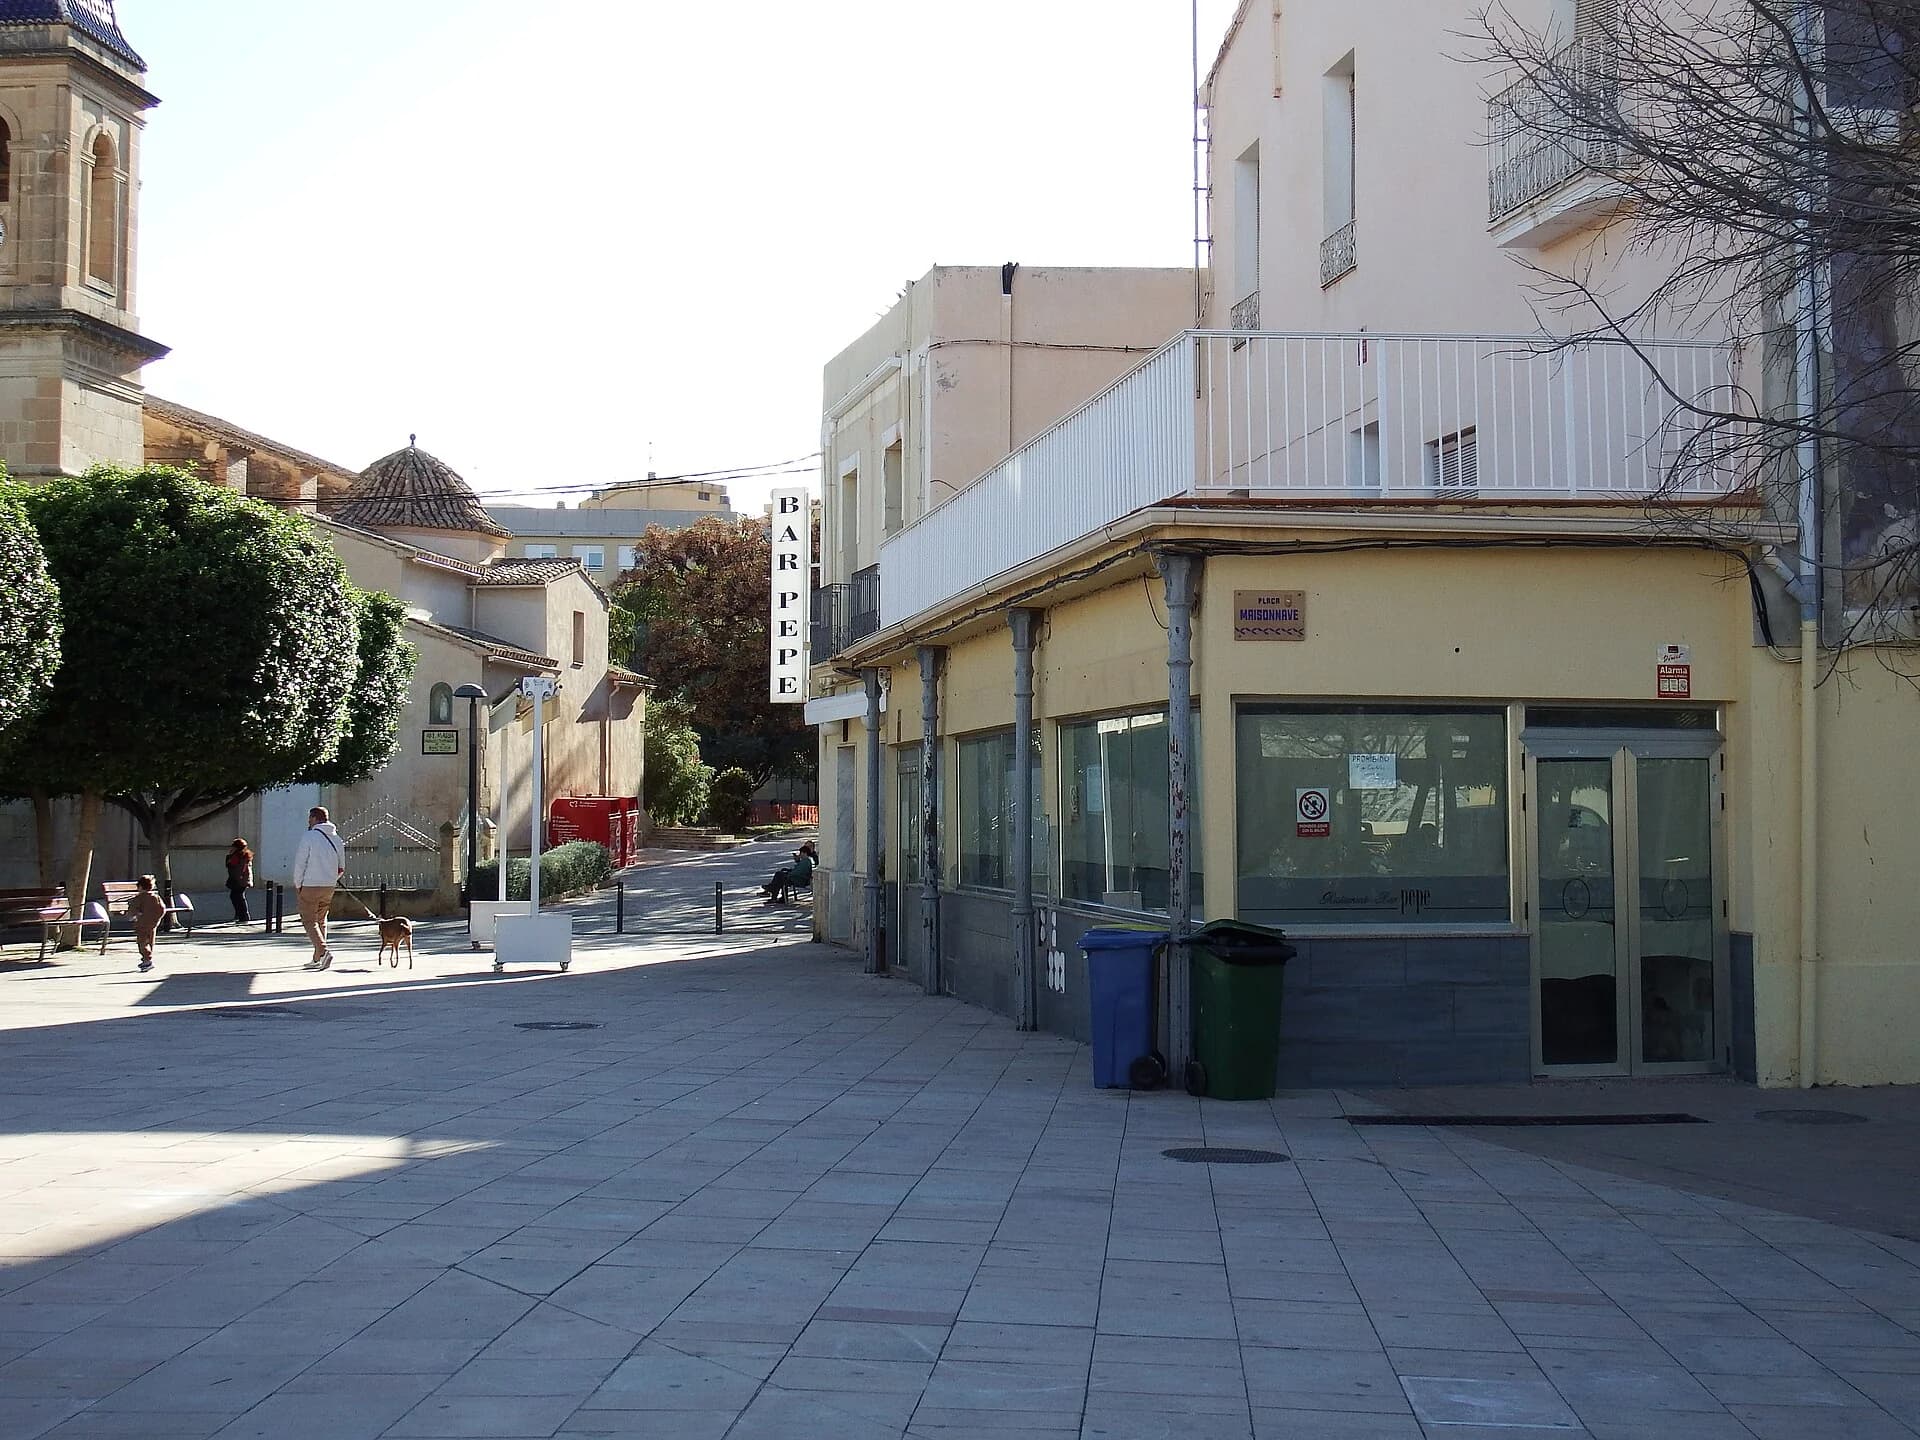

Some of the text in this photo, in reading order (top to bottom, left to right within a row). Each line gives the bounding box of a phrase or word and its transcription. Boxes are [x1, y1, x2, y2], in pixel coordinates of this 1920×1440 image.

[776, 496, 800, 695] BAR PEPE
[1240, 608, 1299, 621] MAISONNAVE
[1659, 665, 1689, 674] Alarma
[1401, 888, 1432, 914] pepe
